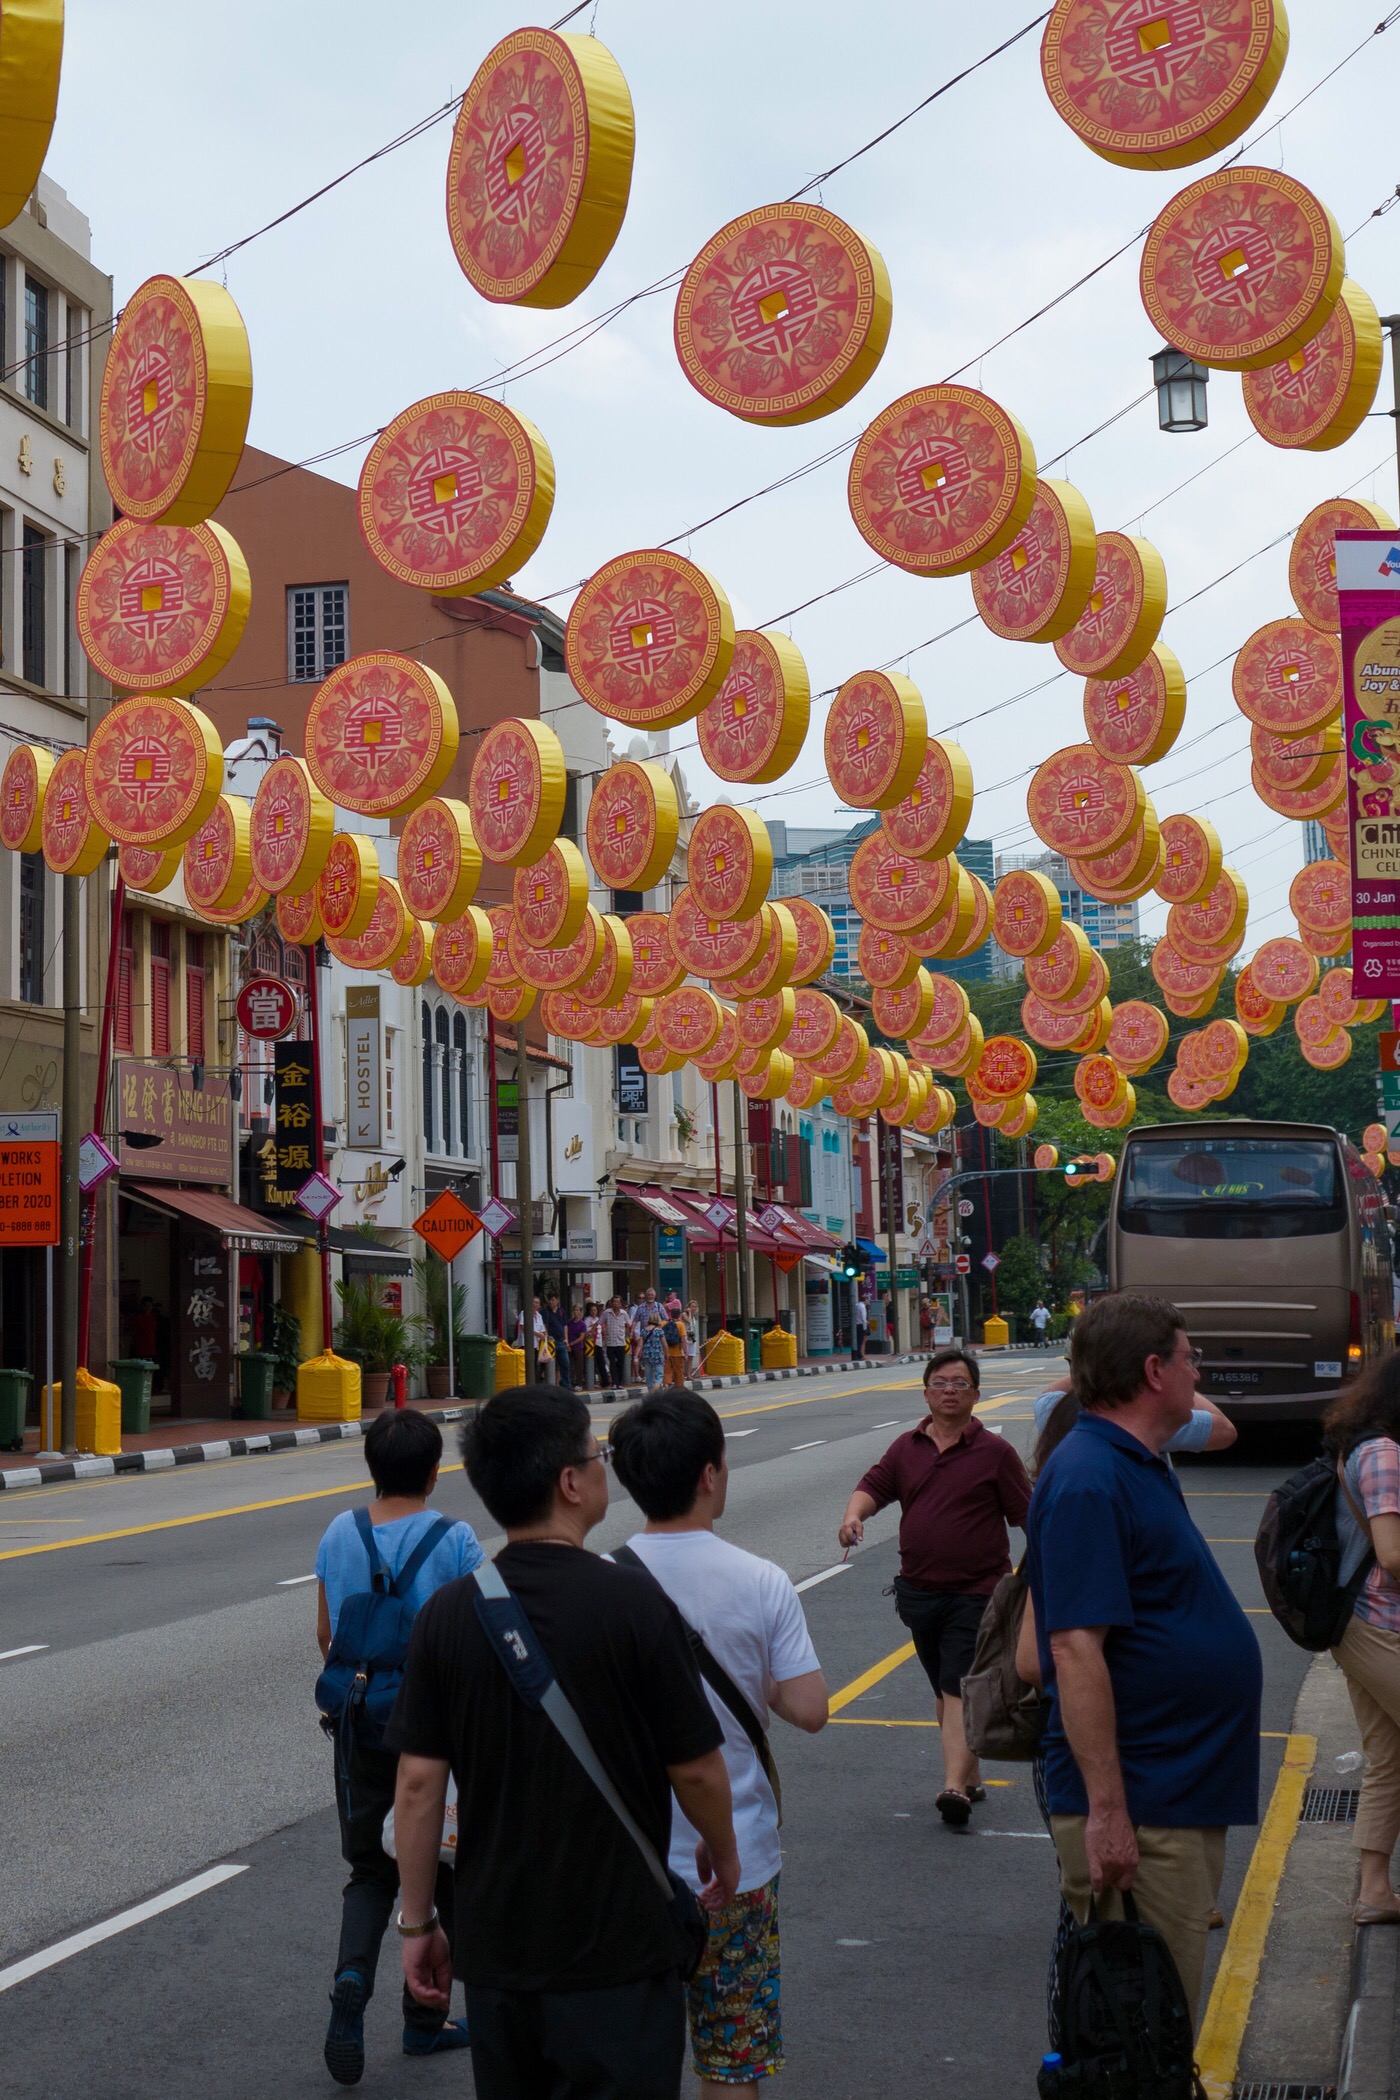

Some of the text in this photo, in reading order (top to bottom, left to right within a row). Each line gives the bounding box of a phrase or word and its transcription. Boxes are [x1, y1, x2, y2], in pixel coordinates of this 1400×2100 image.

[1361, 663, 1400, 676] Abun
[1361, 679, 1387, 693] Joy
[1376, 862, 1400, 872] CEL
[1356, 892, 1396, 904] 30 Jan
[247, 986, 285, 1031] 當
[357, 1032, 370, 1109] HOSTEL
[621, 1066, 644, 1090] 5
[178, 1088, 203, 1123] HENG
[206, 1094, 228, 1126] FATT
[276, 1062, 313, 1170] 金裕源
[20, 1123, 51, 1134] Authority
[178, 1132, 206, 1150] PAWNSHOP
[207, 1136, 217, 1151] PTE
[218, 1138, 228, 1152] LTD
[1, 1151, 41, 1165] WORKS
[0, 1172, 42, 1187] LETION
[23, 1195, 52, 1208] 2020
[422, 1219, 474, 1232] CAUTION
[1211, 1372, 1259, 1382] PA6538G
